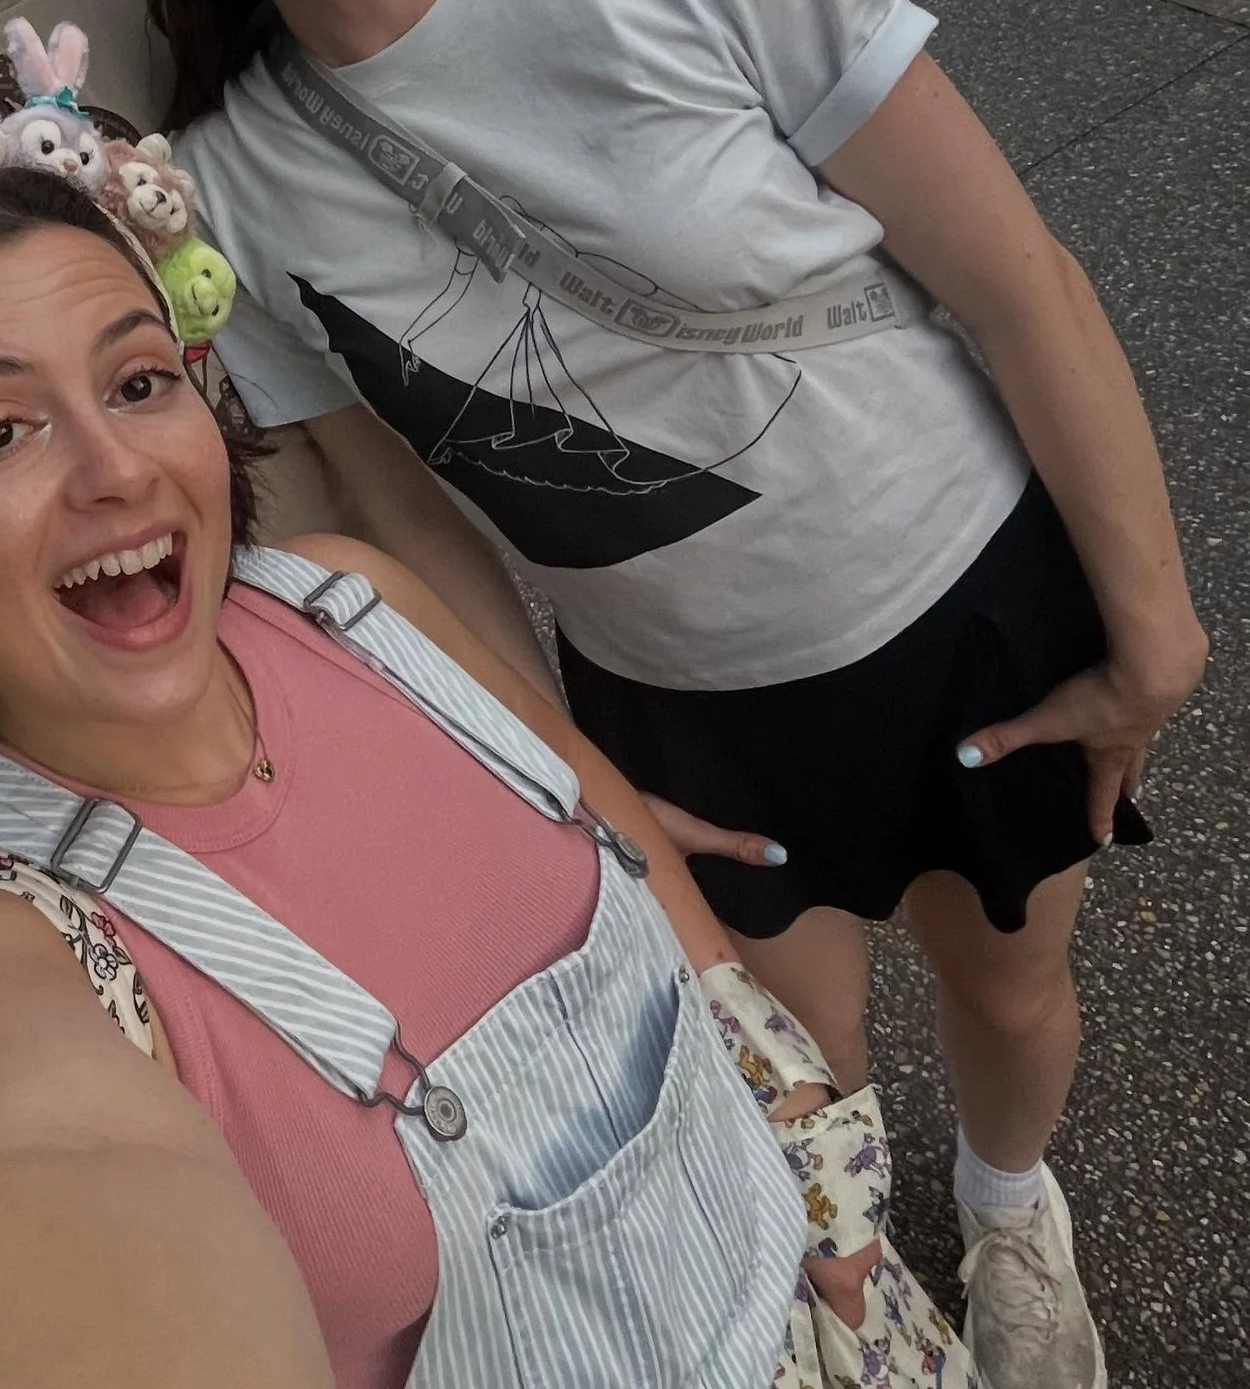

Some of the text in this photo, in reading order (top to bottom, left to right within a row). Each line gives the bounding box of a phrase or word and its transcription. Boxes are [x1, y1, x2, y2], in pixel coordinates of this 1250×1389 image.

[558, 271, 616, 315] Walt
[741, 314, 804, 343] World
[826, 301, 867, 330] Walt
